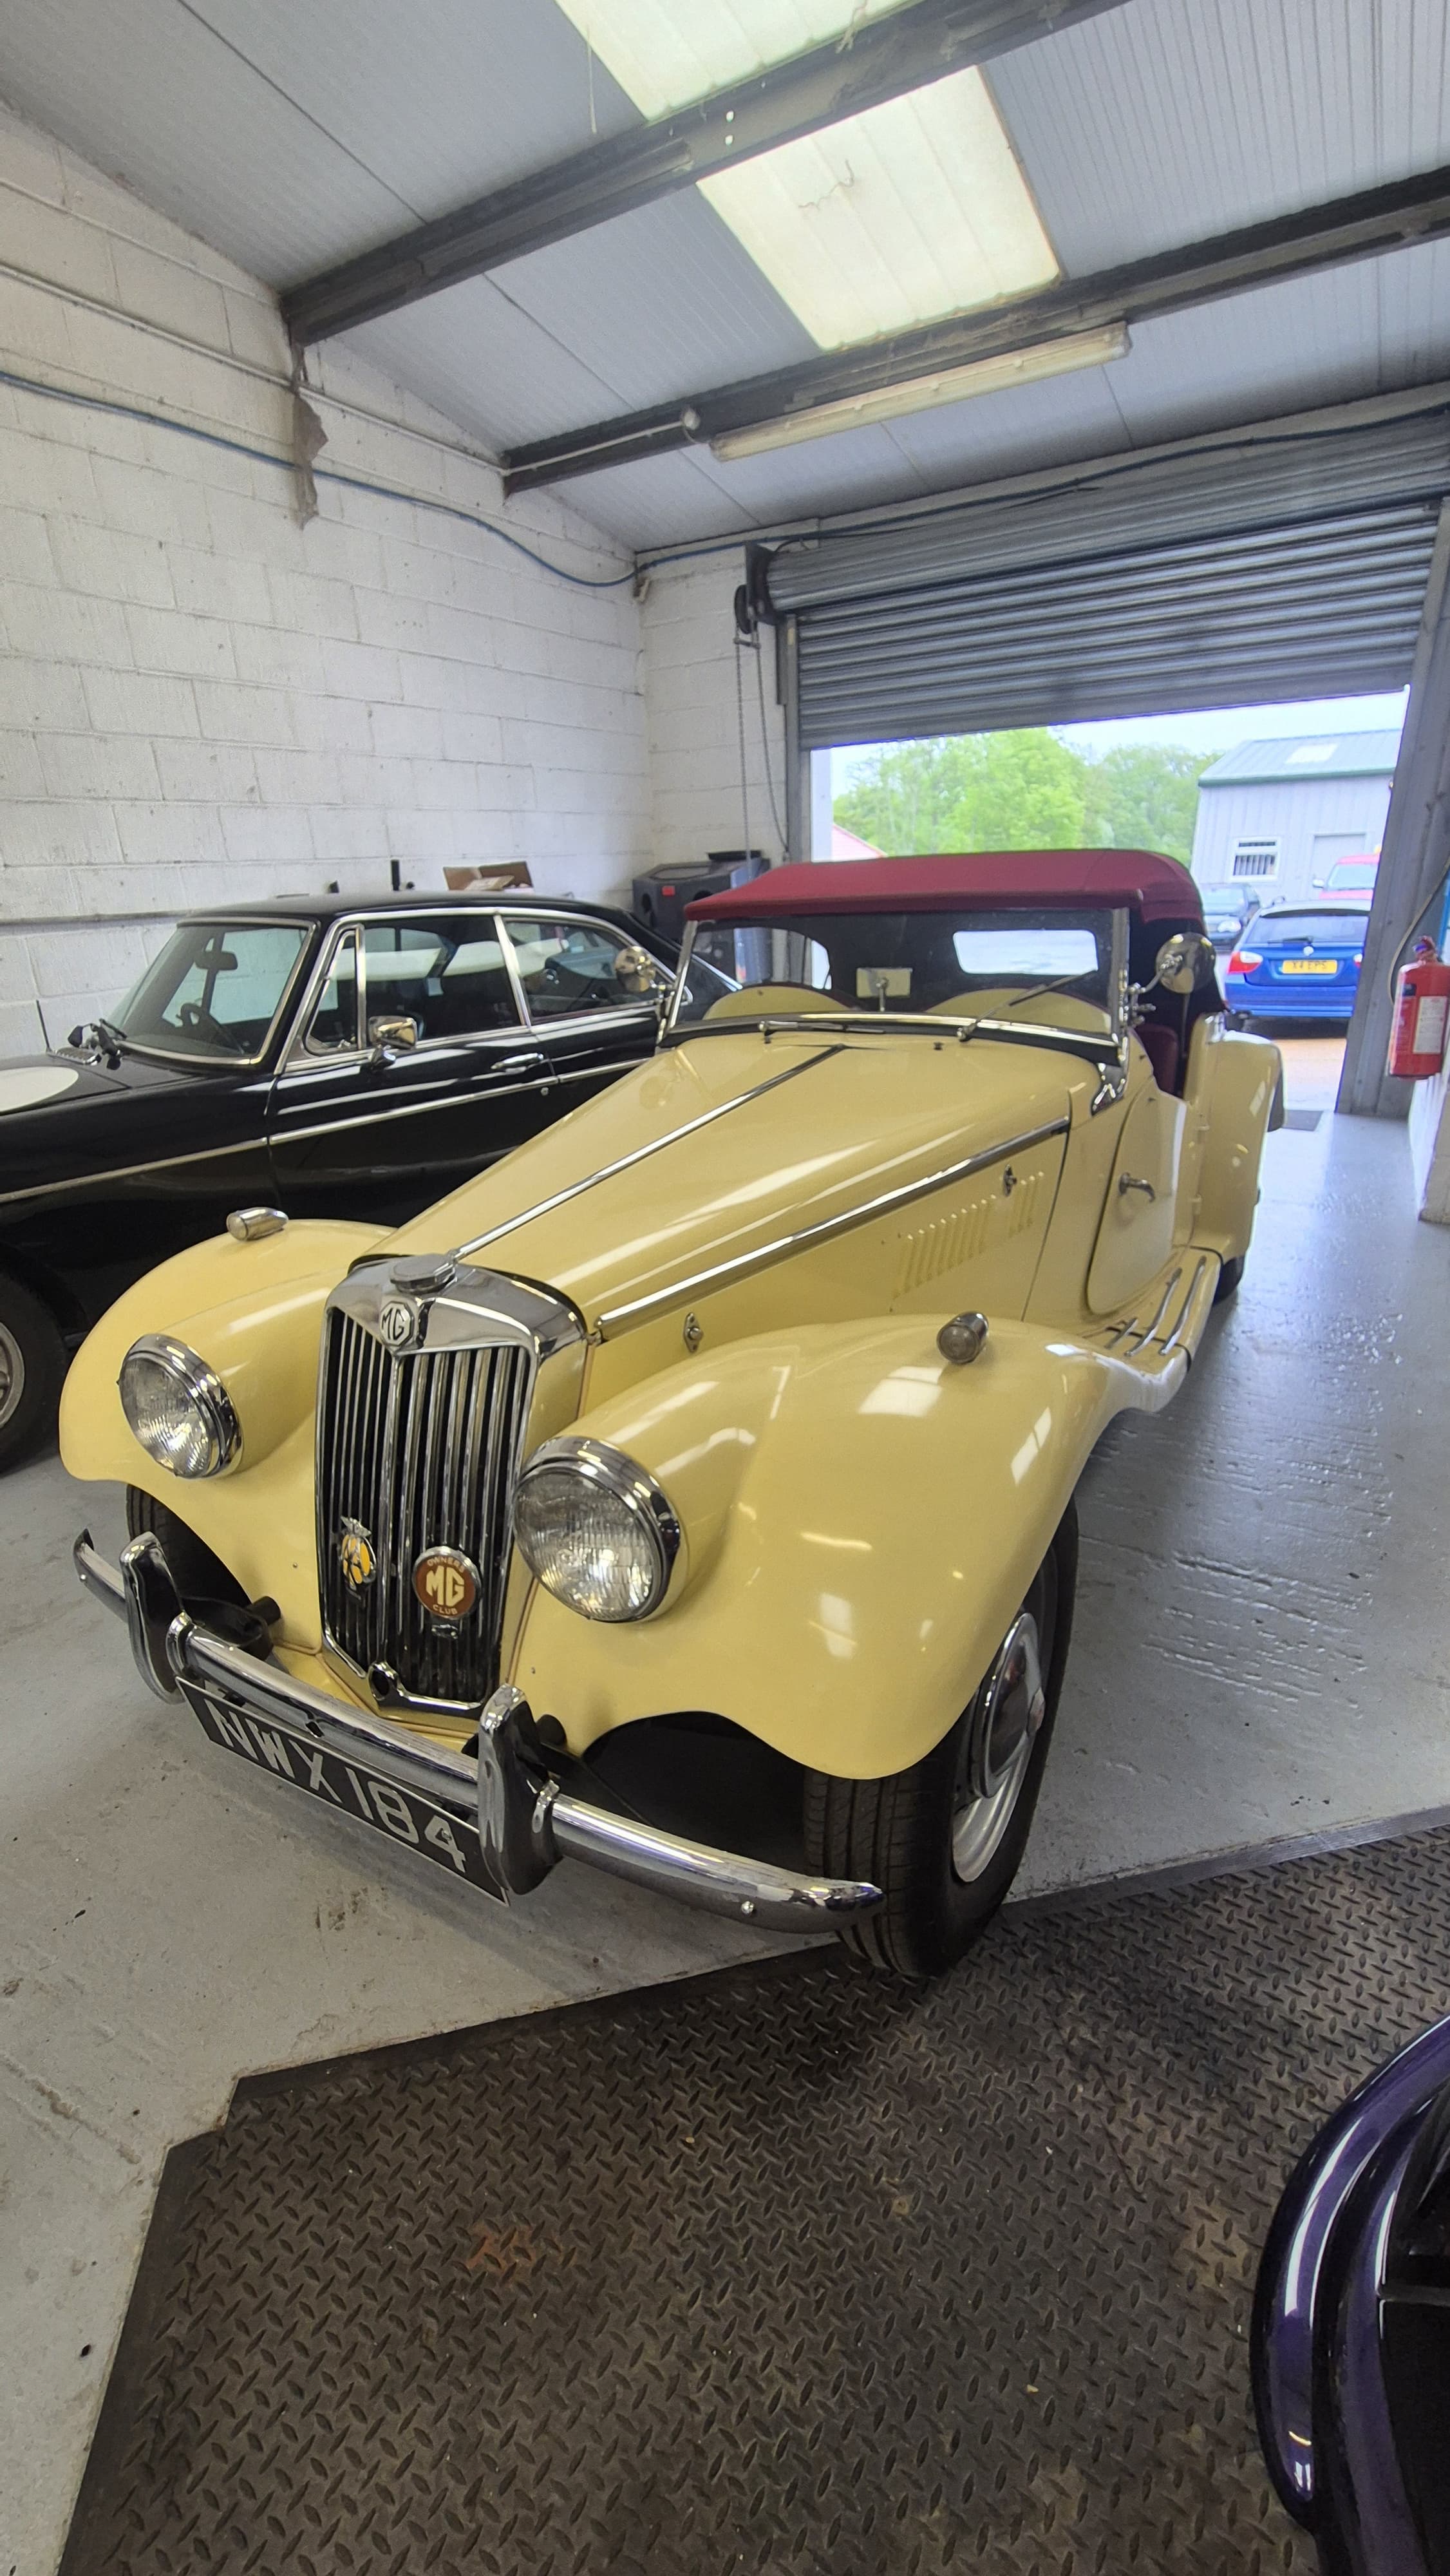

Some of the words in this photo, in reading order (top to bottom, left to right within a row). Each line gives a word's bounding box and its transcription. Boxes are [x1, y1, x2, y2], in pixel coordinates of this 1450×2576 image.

[381, 1306, 406, 1341] MG
[427, 1557, 465, 1573] OWNERS
[426, 1565, 465, 1607] MG
[433, 1604, 458, 1615] CLUB
[203, 1698, 343, 1803] NWX
[345, 1766, 466, 1873] 184
